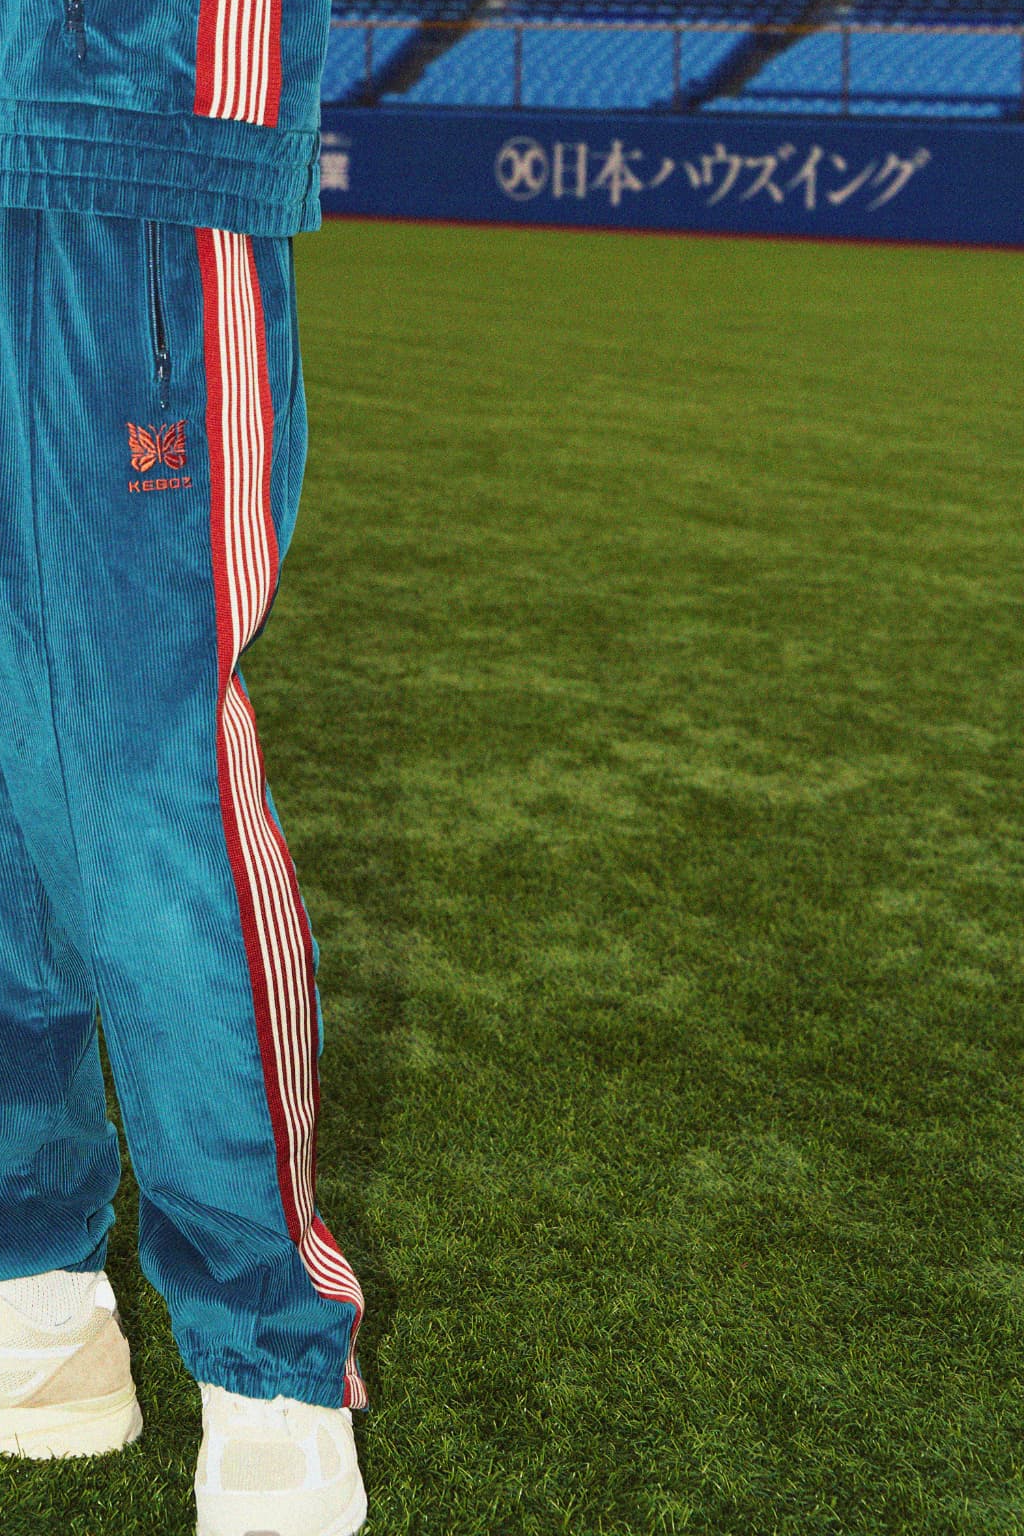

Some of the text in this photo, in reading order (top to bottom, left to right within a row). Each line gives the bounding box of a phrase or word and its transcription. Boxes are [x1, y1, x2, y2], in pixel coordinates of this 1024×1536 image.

[553, 138, 932, 210] 日本ハウズイング
[128, 476, 193, 493] KEBOZ
